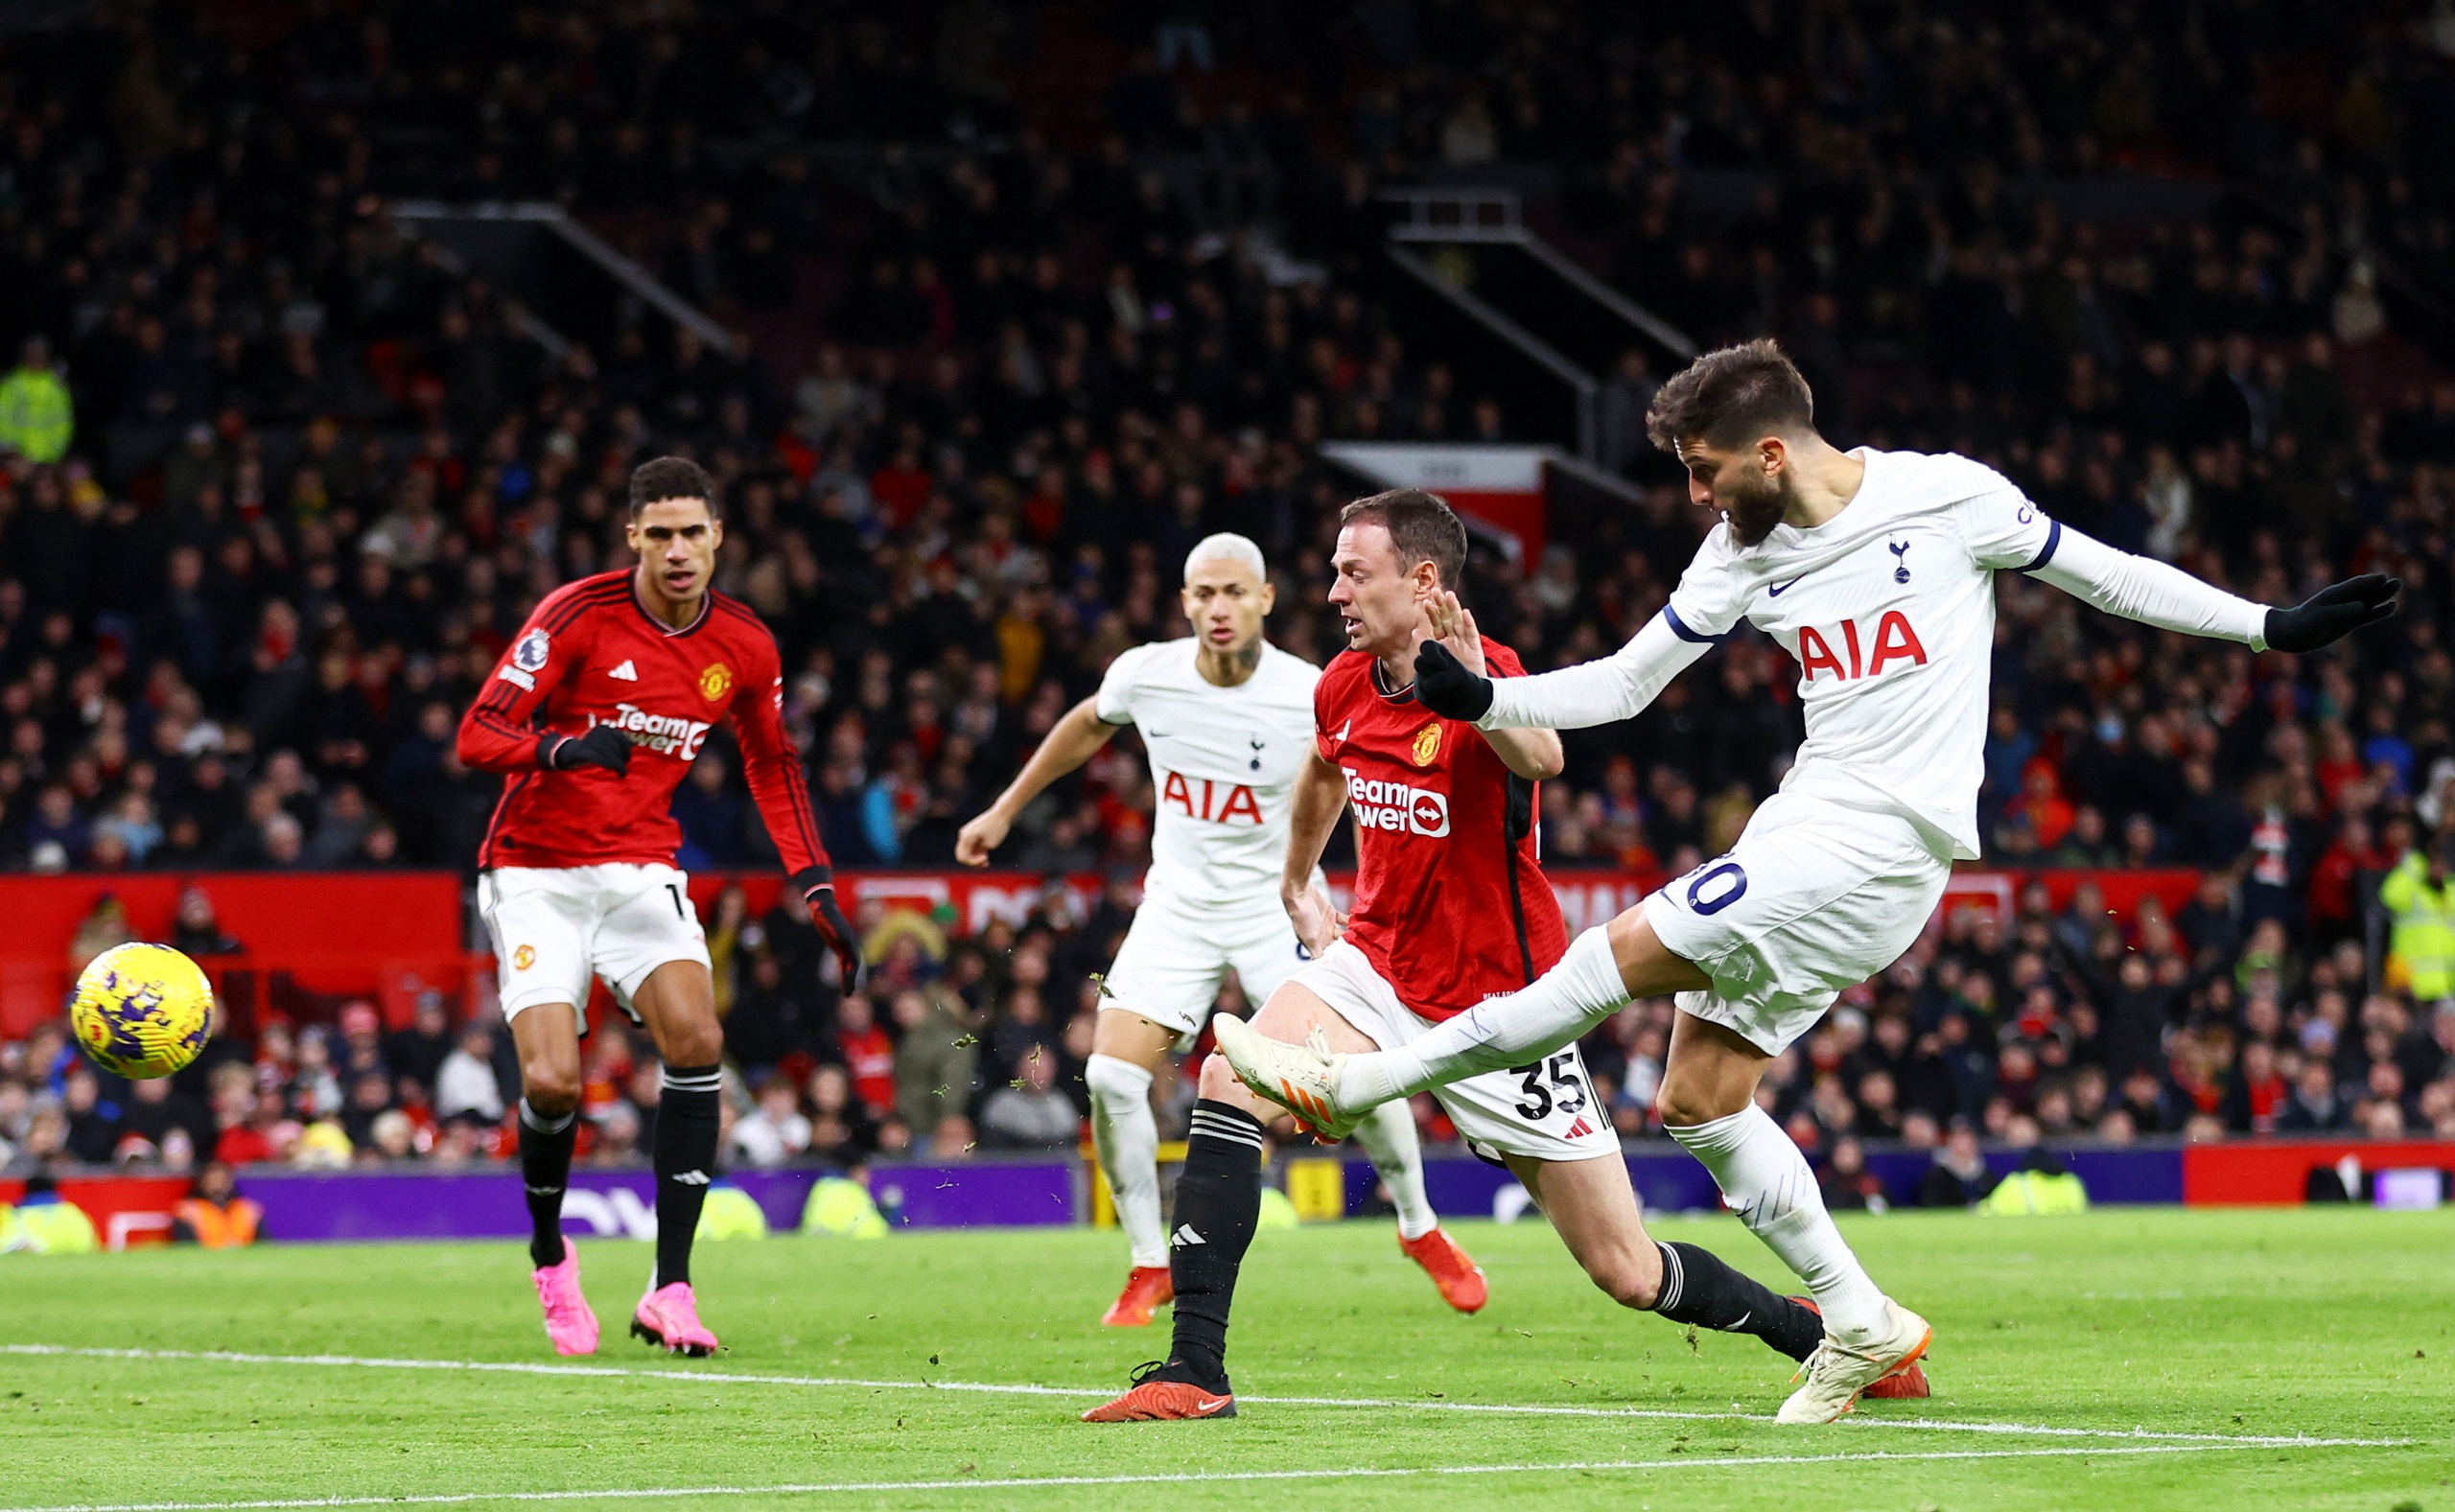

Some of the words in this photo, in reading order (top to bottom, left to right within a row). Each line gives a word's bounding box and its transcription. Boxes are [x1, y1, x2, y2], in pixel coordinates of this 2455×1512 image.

[1799, 611, 1928, 682] AIA
[616, 703, 690, 738] Team
[1164, 771, 1263, 824] AIA
[1342, 767, 1409, 807] Team
[1509, 1052, 1586, 1121] 35
